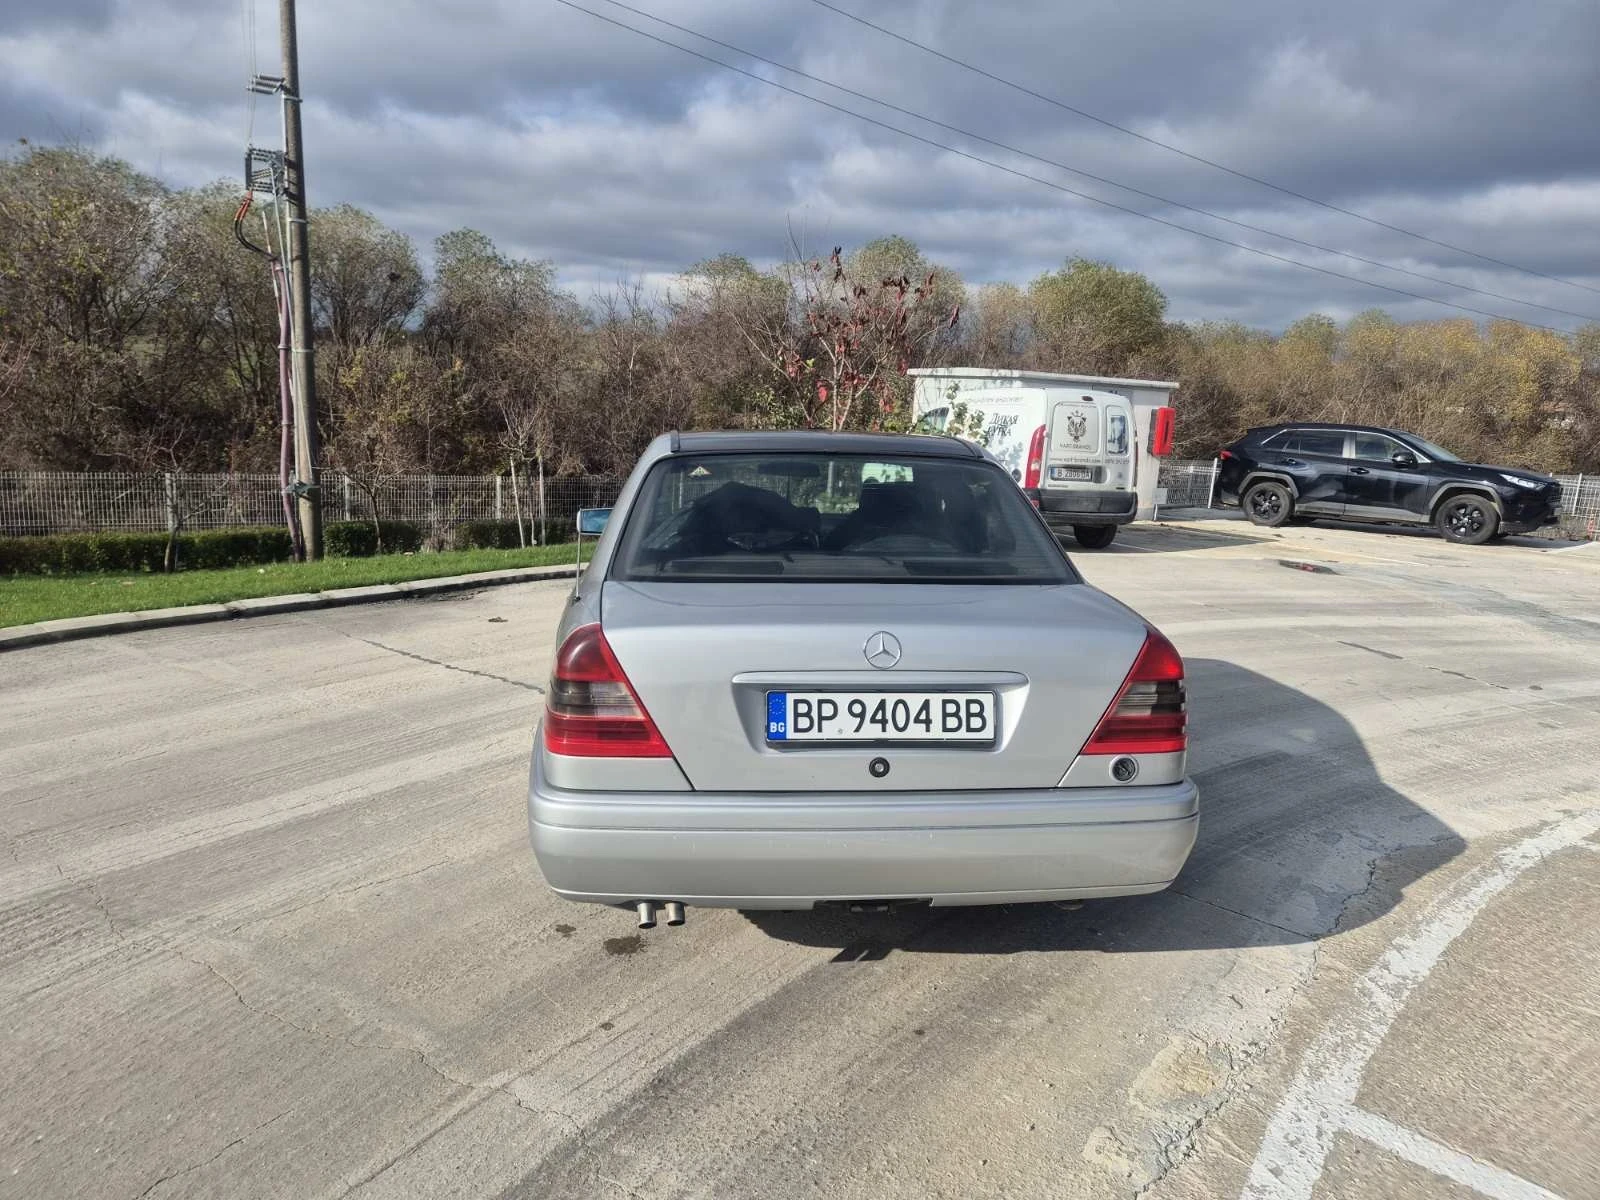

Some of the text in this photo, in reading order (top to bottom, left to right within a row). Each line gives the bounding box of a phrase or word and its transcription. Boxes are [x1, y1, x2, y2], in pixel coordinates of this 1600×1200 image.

[792, 698, 987, 733] BP 9404 BB
[769, 722, 785, 733] BG
